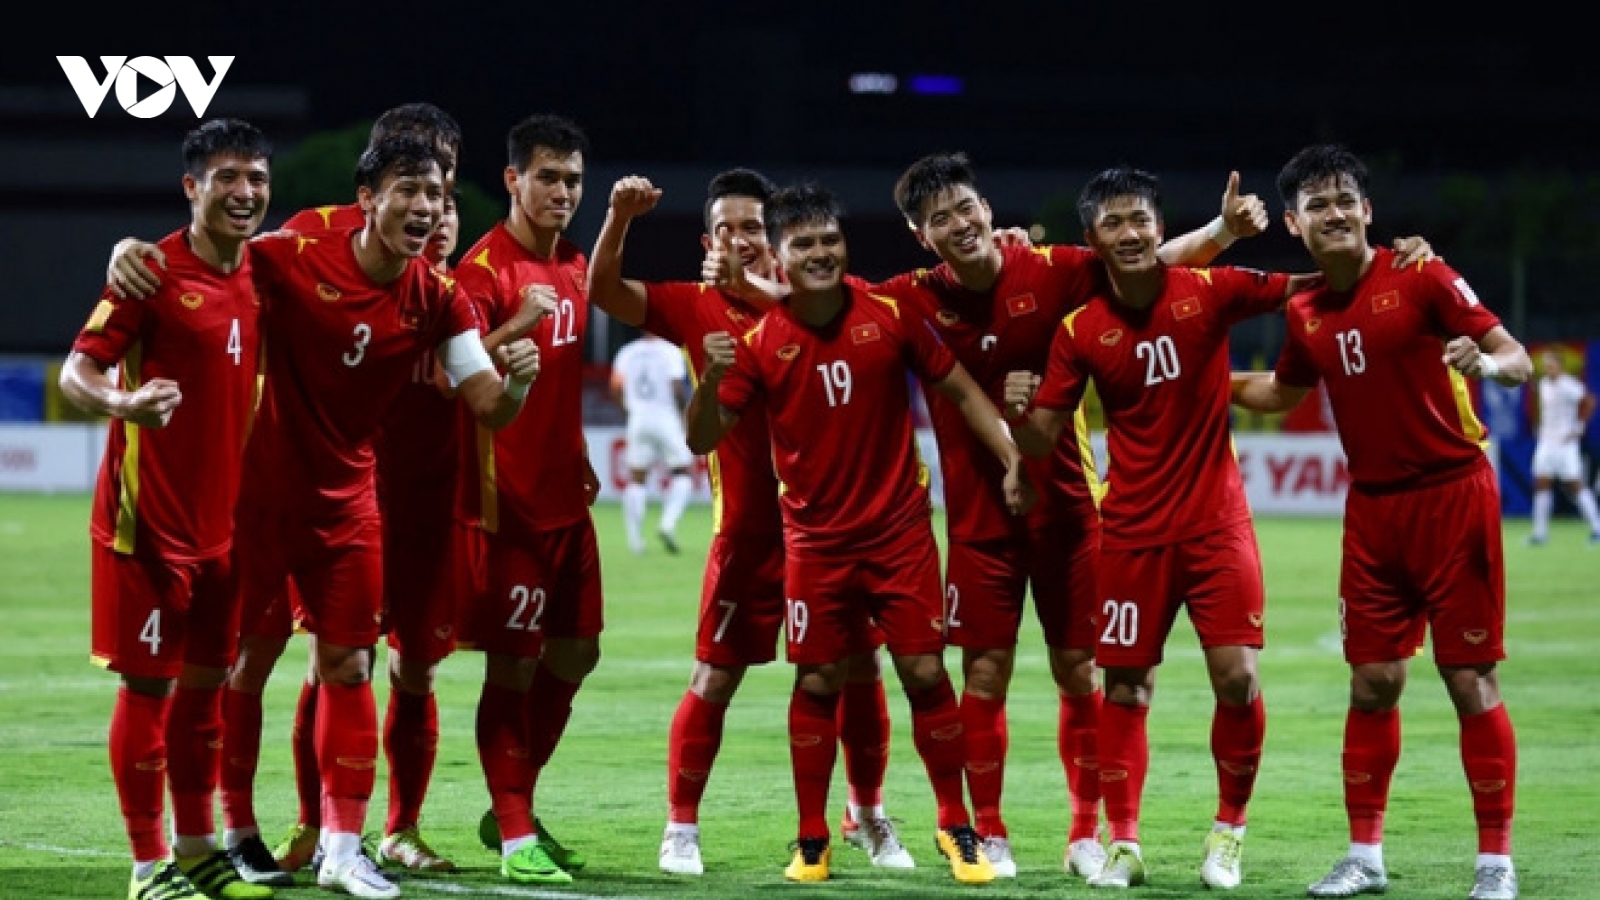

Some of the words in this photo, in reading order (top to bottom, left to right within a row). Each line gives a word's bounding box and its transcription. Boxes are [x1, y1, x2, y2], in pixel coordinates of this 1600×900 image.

[226, 318, 243, 366] 4
[342, 322, 372, 368] 3
[1135, 335, 1181, 387] 20
[1335, 328, 1366, 376] 13
[816, 360, 852, 407] 19
[138, 607, 163, 656] 4
[504, 584, 546, 632] 22
[712, 599, 738, 643] 7
[786, 597, 809, 645] 19
[1100, 598, 1139, 647] 20
